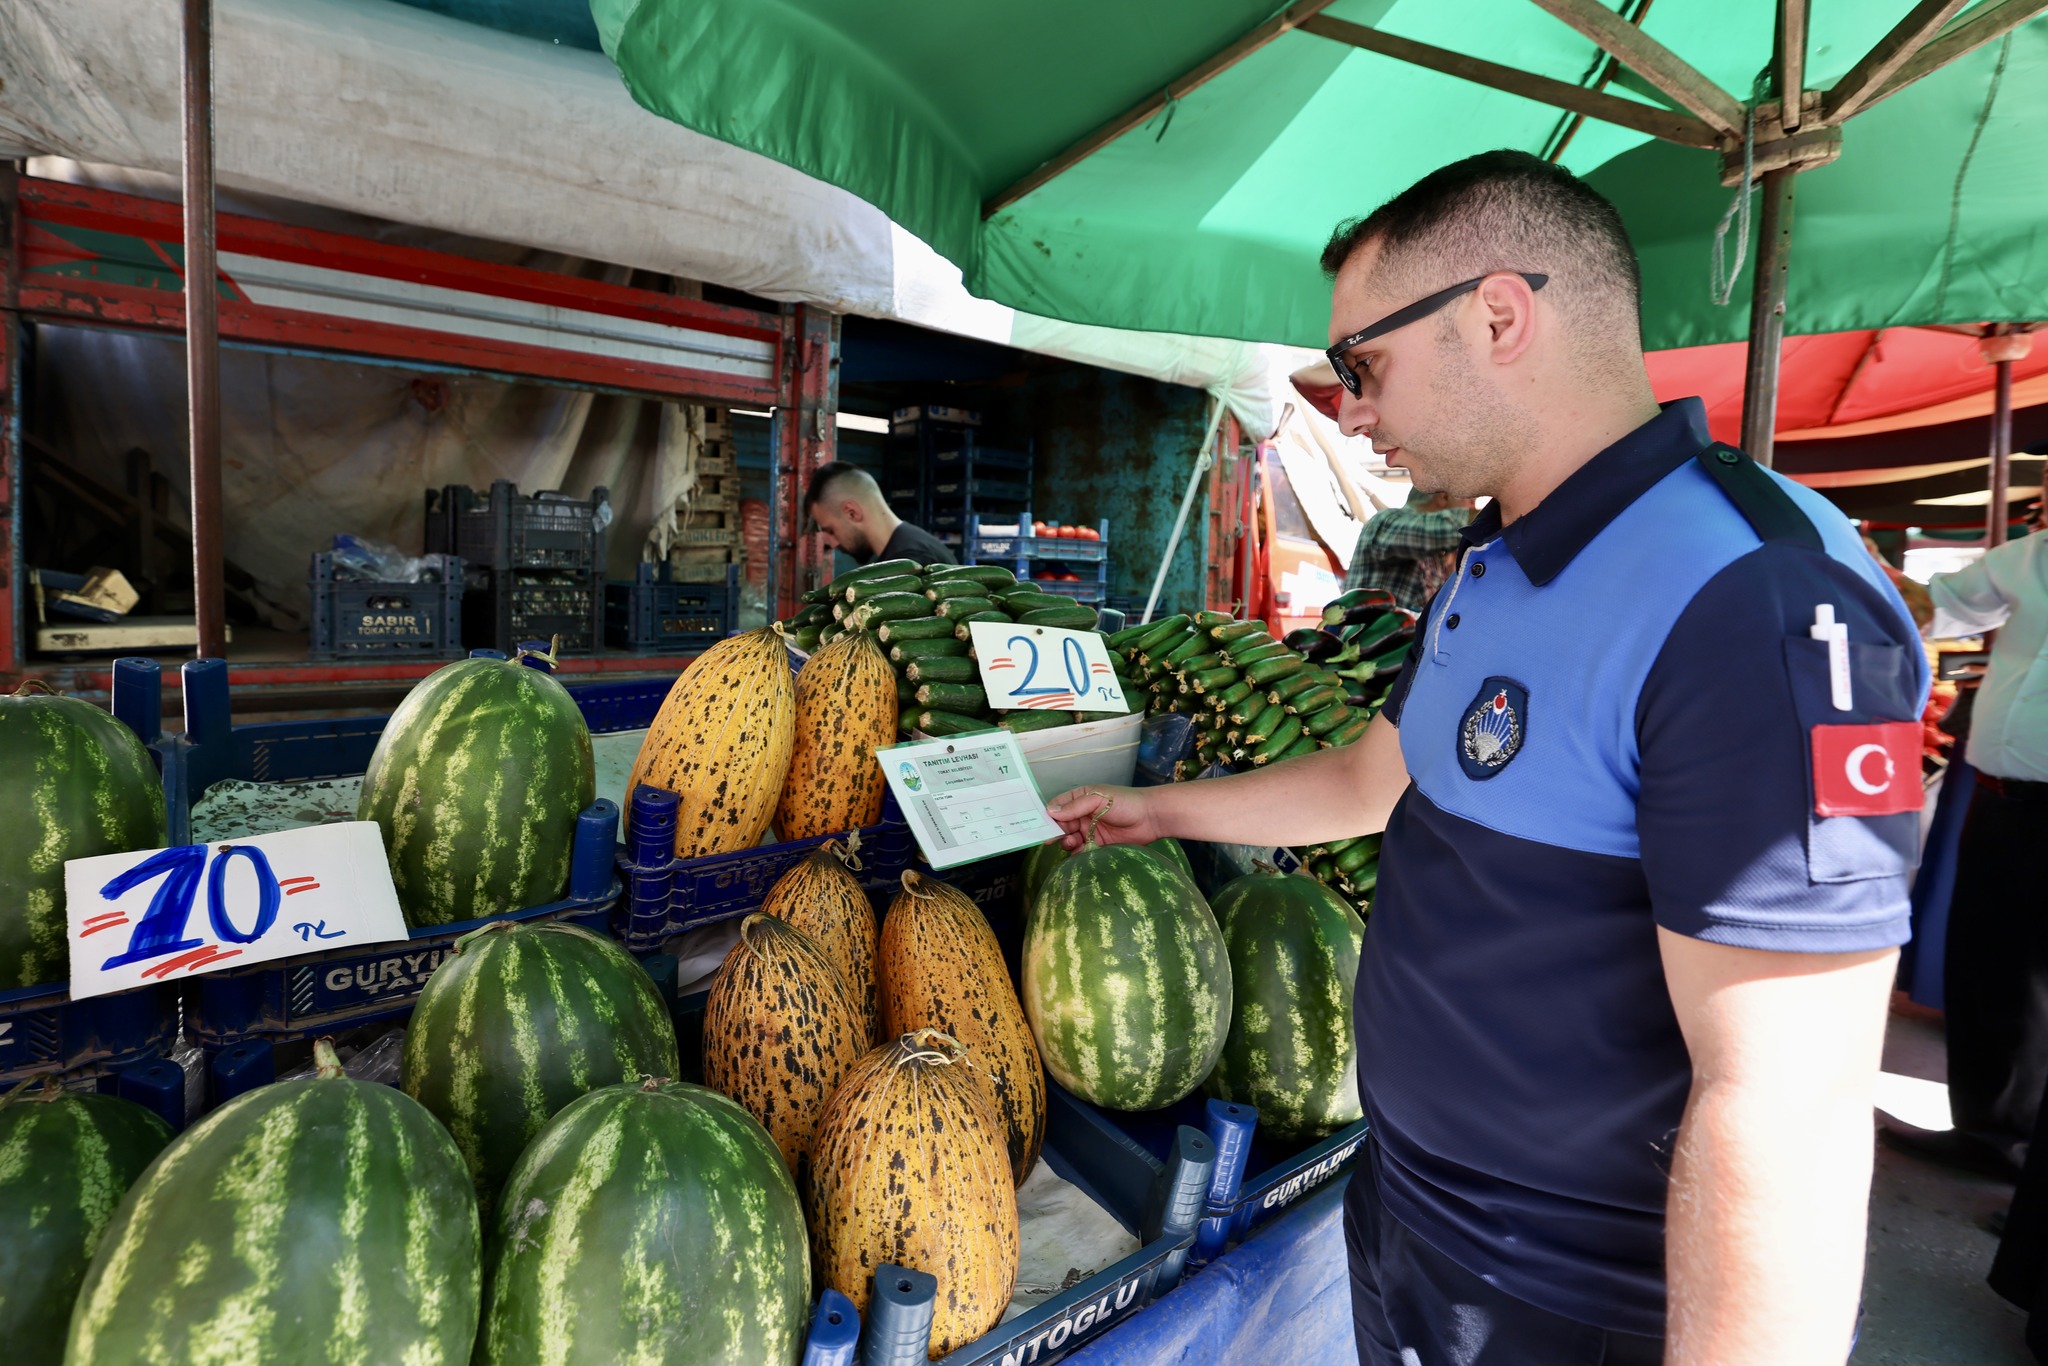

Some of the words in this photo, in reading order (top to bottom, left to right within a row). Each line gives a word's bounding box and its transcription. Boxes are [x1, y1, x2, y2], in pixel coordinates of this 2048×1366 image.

[362, 615, 416, 626] SABIR
[1007, 635, 1091, 697] 20
[922, 758, 952, 768] TANITIM
[951, 753, 979, 764] LEVHASI
[998, 765, 1009, 775] 17
[100, 842, 282, 972] 10
[1279, 1164, 1340, 1208] TARIM
[985, 1277, 1140, 1366] NTOGLU
